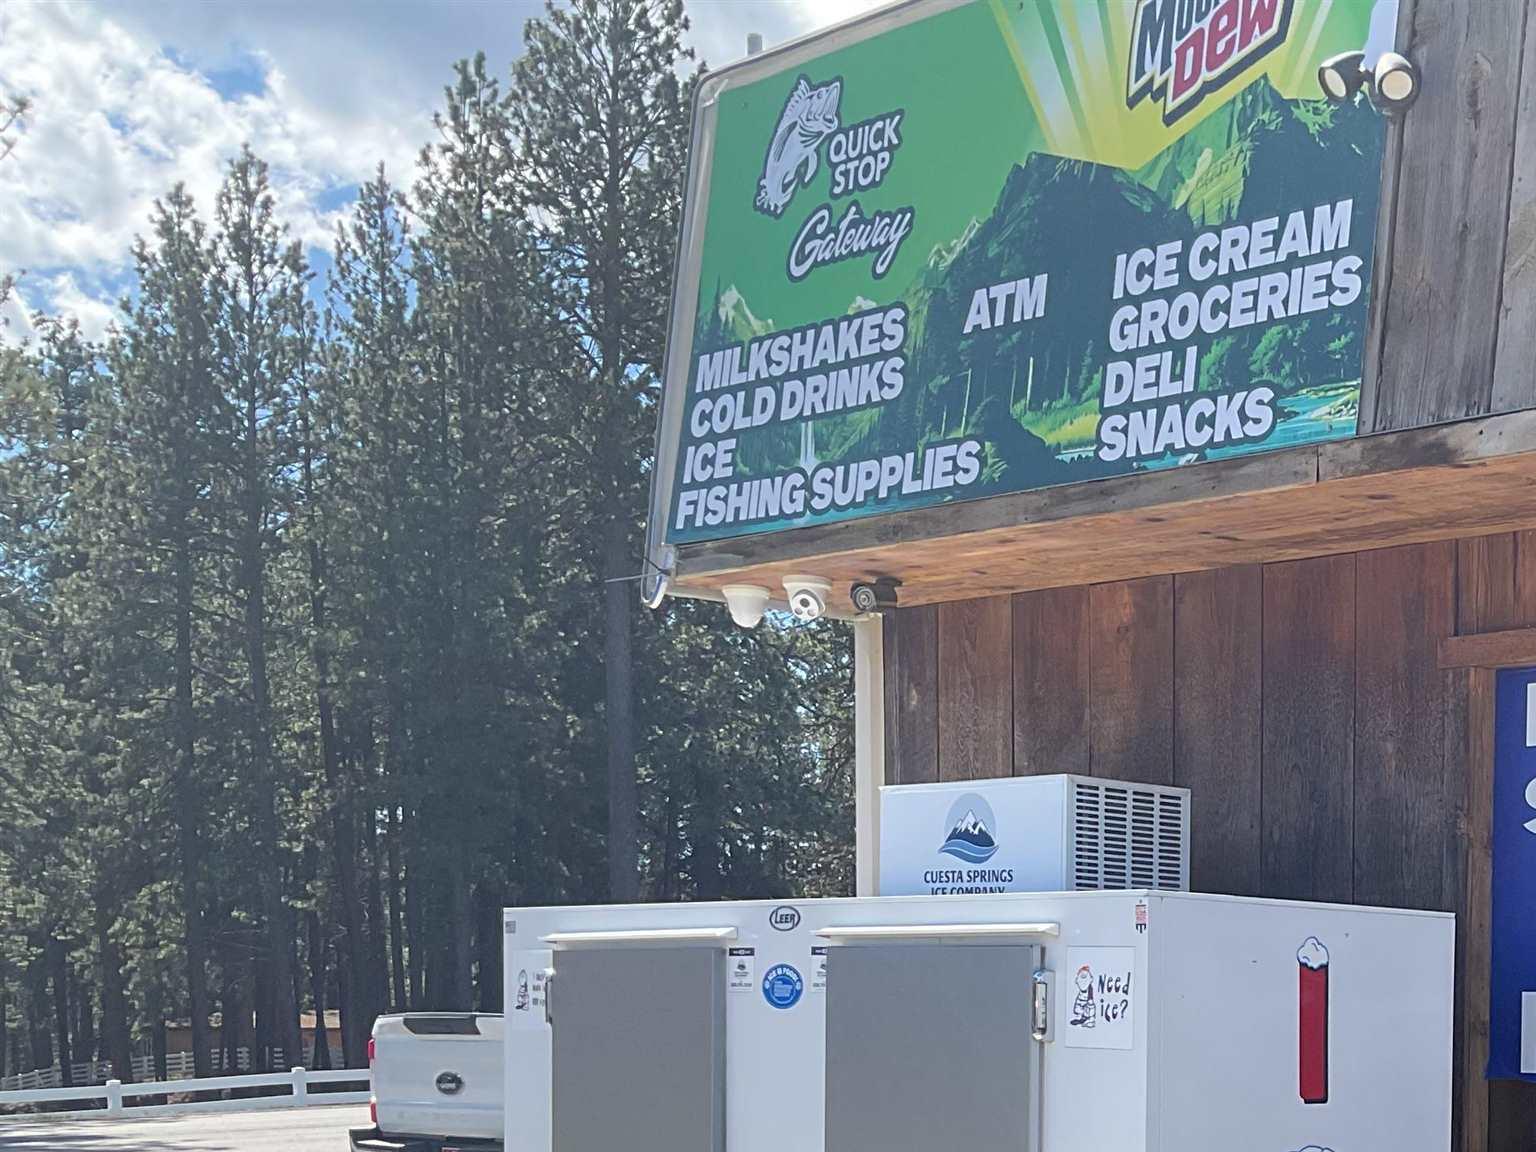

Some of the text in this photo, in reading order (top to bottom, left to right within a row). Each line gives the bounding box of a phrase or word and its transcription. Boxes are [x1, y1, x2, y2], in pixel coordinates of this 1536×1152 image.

[829, 115, 900, 163] QUICK
[833, 151, 890, 194] STOP
[790, 205, 911, 277] Gateway
[1112, 198, 1353, 299] ICE CREAM
[962, 273, 1048, 334] ATM
[1109, 255, 1363, 353] GROCERIES
[696, 307, 905, 393] MILKSHAKES
[1103, 345, 1198, 408] DELI
[691, 356, 905, 438] COLD DRINKS
[1099, 386, 1275, 462] SNACKS
[675, 440, 981, 530] FISHING SUPPLIES
[683, 438, 736, 484] ICE
[924, 869, 1014, 884] CUESTA SPRINGS
[1098, 971, 1131, 995] Need
[1100, 999, 1129, 1022] ice?
